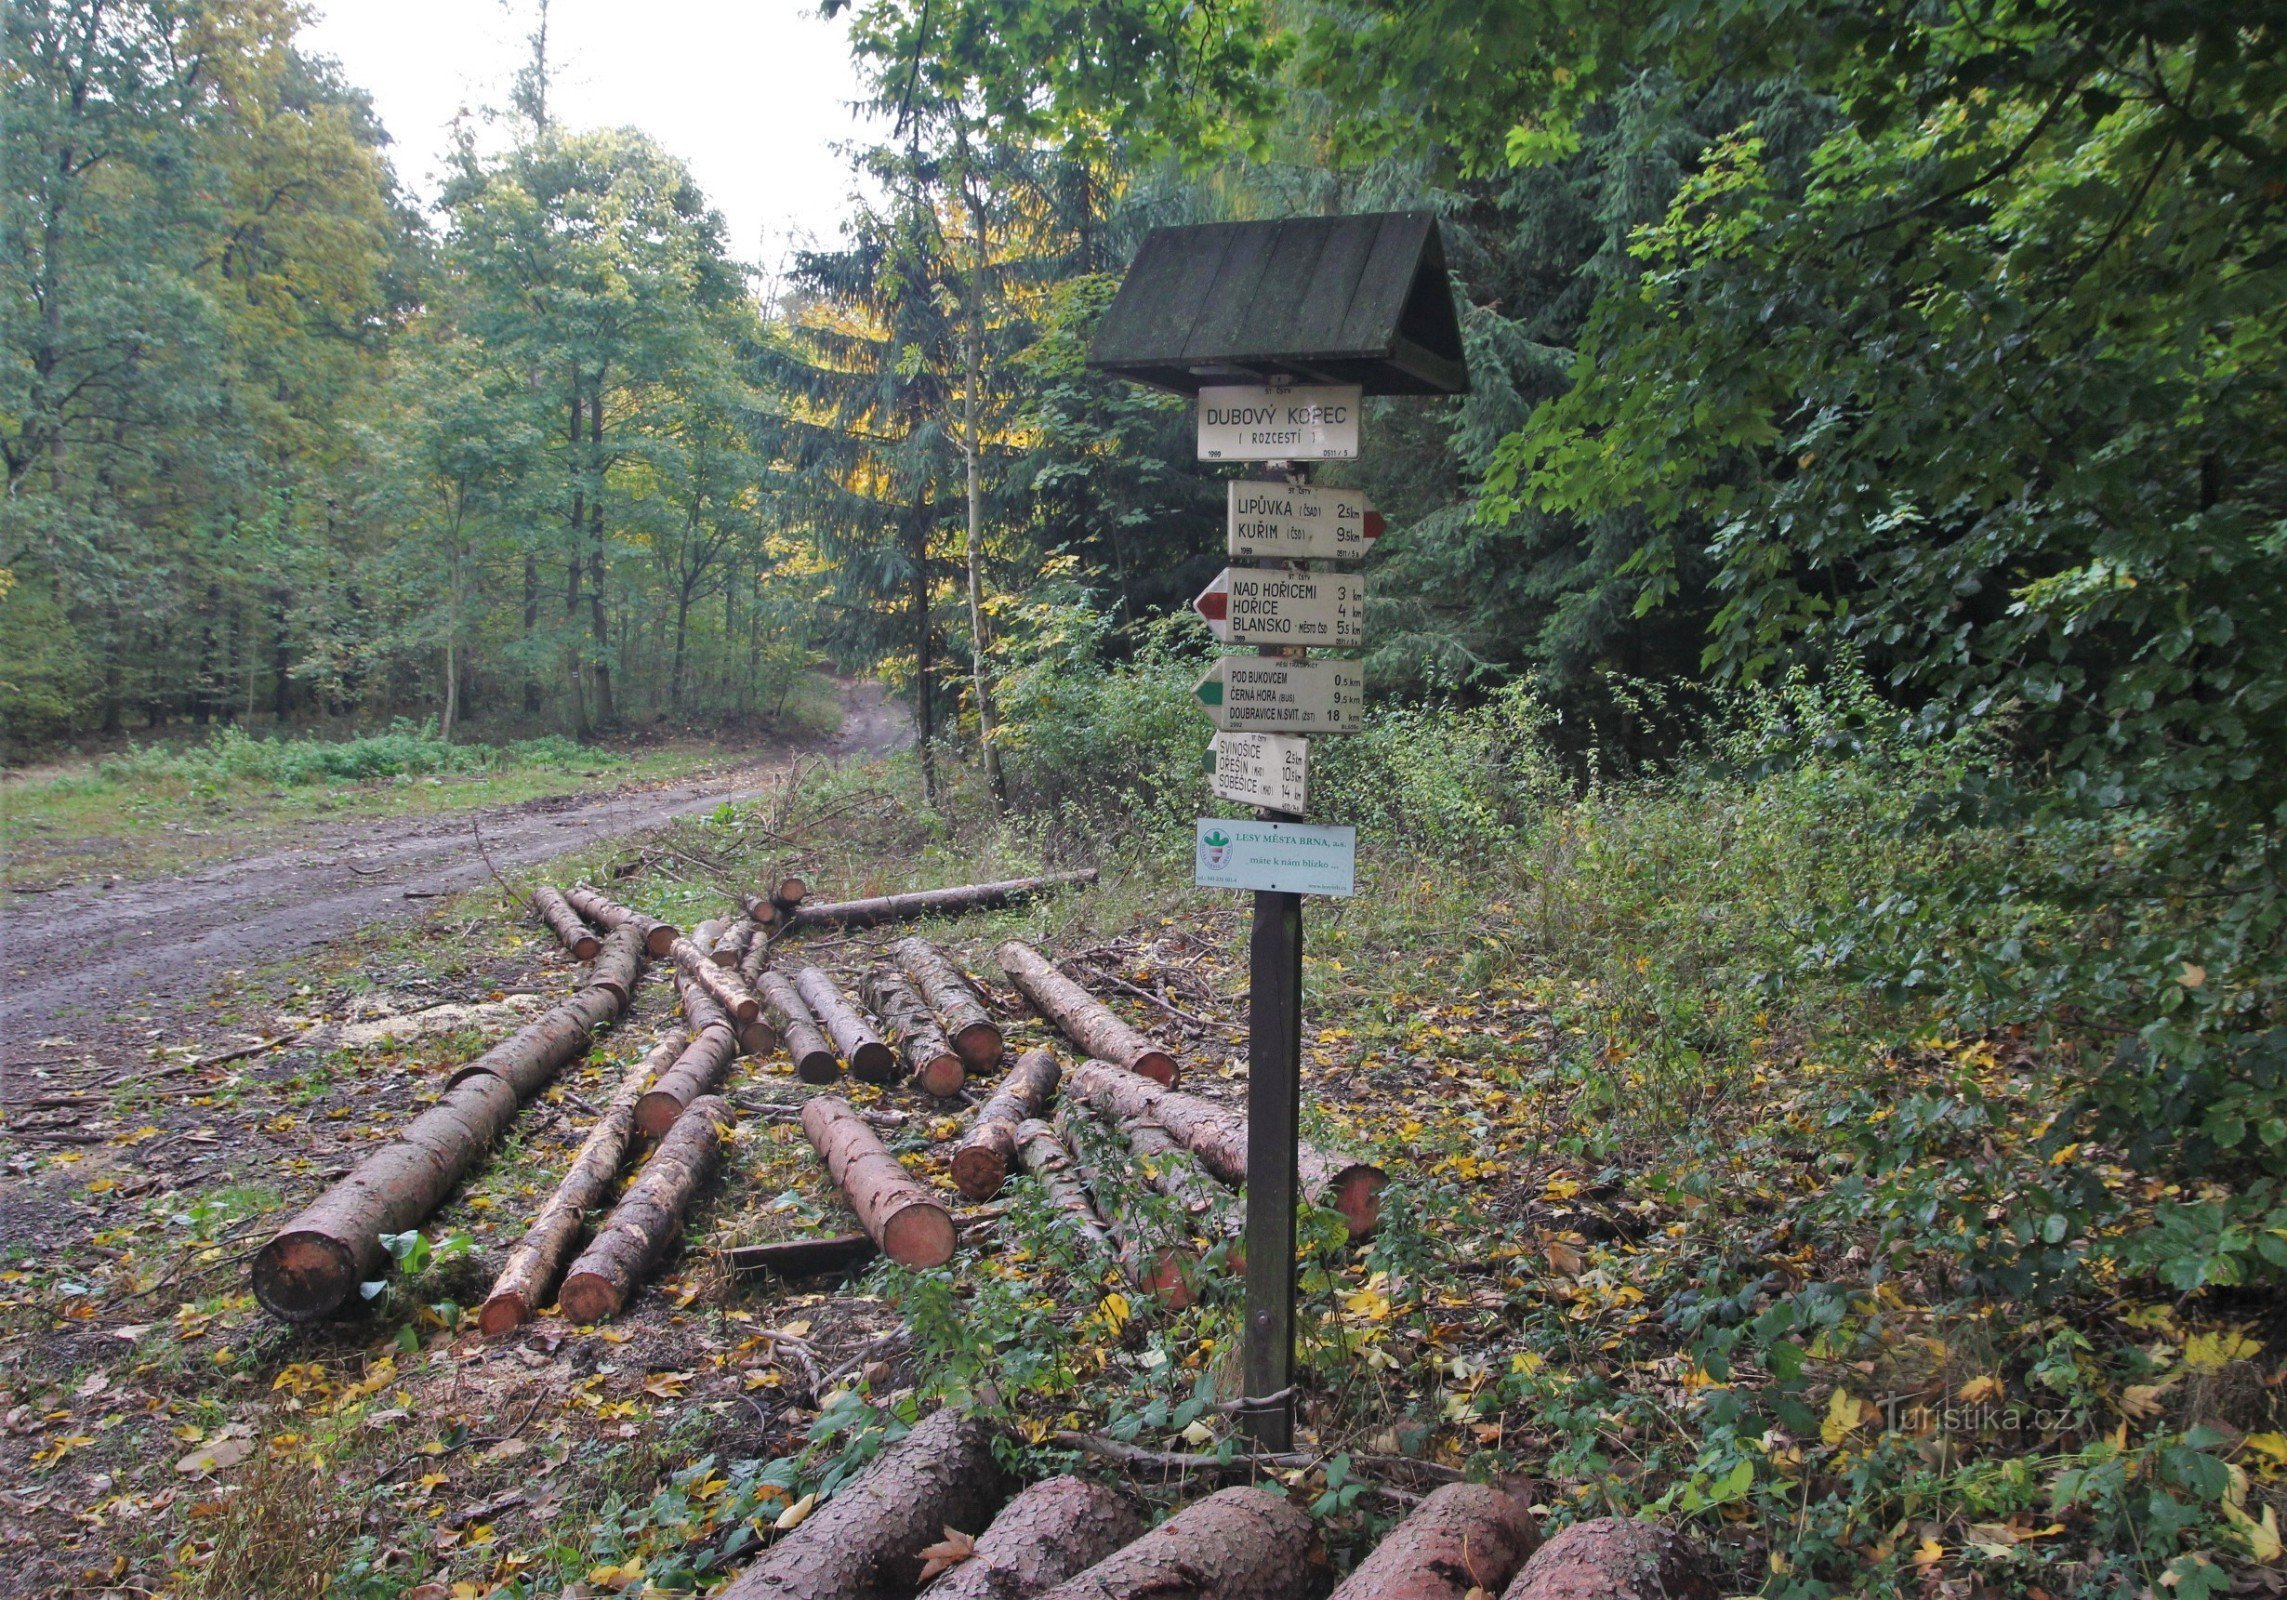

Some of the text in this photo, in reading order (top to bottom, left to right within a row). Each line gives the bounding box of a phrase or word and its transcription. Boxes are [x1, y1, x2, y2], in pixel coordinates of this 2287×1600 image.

[1207, 403, 1347, 425] DUBOVÝ KOPEC
[1252, 428, 1302, 444] ROZCESTÍ
[1238, 495, 1292, 516] LIPŮVKA
[1238, 520, 1278, 539] KUŘIM
[1233, 581, 1362, 601] NAD HOŘICEMI 3 km
[1232, 597, 1361, 618] HOŘICE 4 km
[1233, 617, 1291, 633] BLANSKO
[1351, 622, 1361, 635] km
[1232, 671, 1247, 683] POD
[1248, 671, 1288, 684] BUKOVCEM
[1349, 678, 1360, 686] km
[1230, 686, 1255, 701] ČERNÁ
[1256, 689, 1276, 701] HORA
[1349, 695, 1360, 704] km
[1230, 707, 1275, 720] DOUBRAVICE
[1327, 710, 1340, 721] 18
[1348, 714, 1360, 722] km
[1220, 740, 1261, 759] SVINOŠICE
[1219, 755, 1248, 775] OŘEŠÍN
[1219, 774, 1257, 793] SOBĚŠICE
[1282, 784, 1290, 799] 14
[1236, 833, 1261, 842] LESY
[1263, 834, 1297, 844] MĚSTA
[1299, 837, 1331, 848] BRNA,
[1281, 858, 1300, 866] nám
[1302, 859, 1329, 868] blízko
